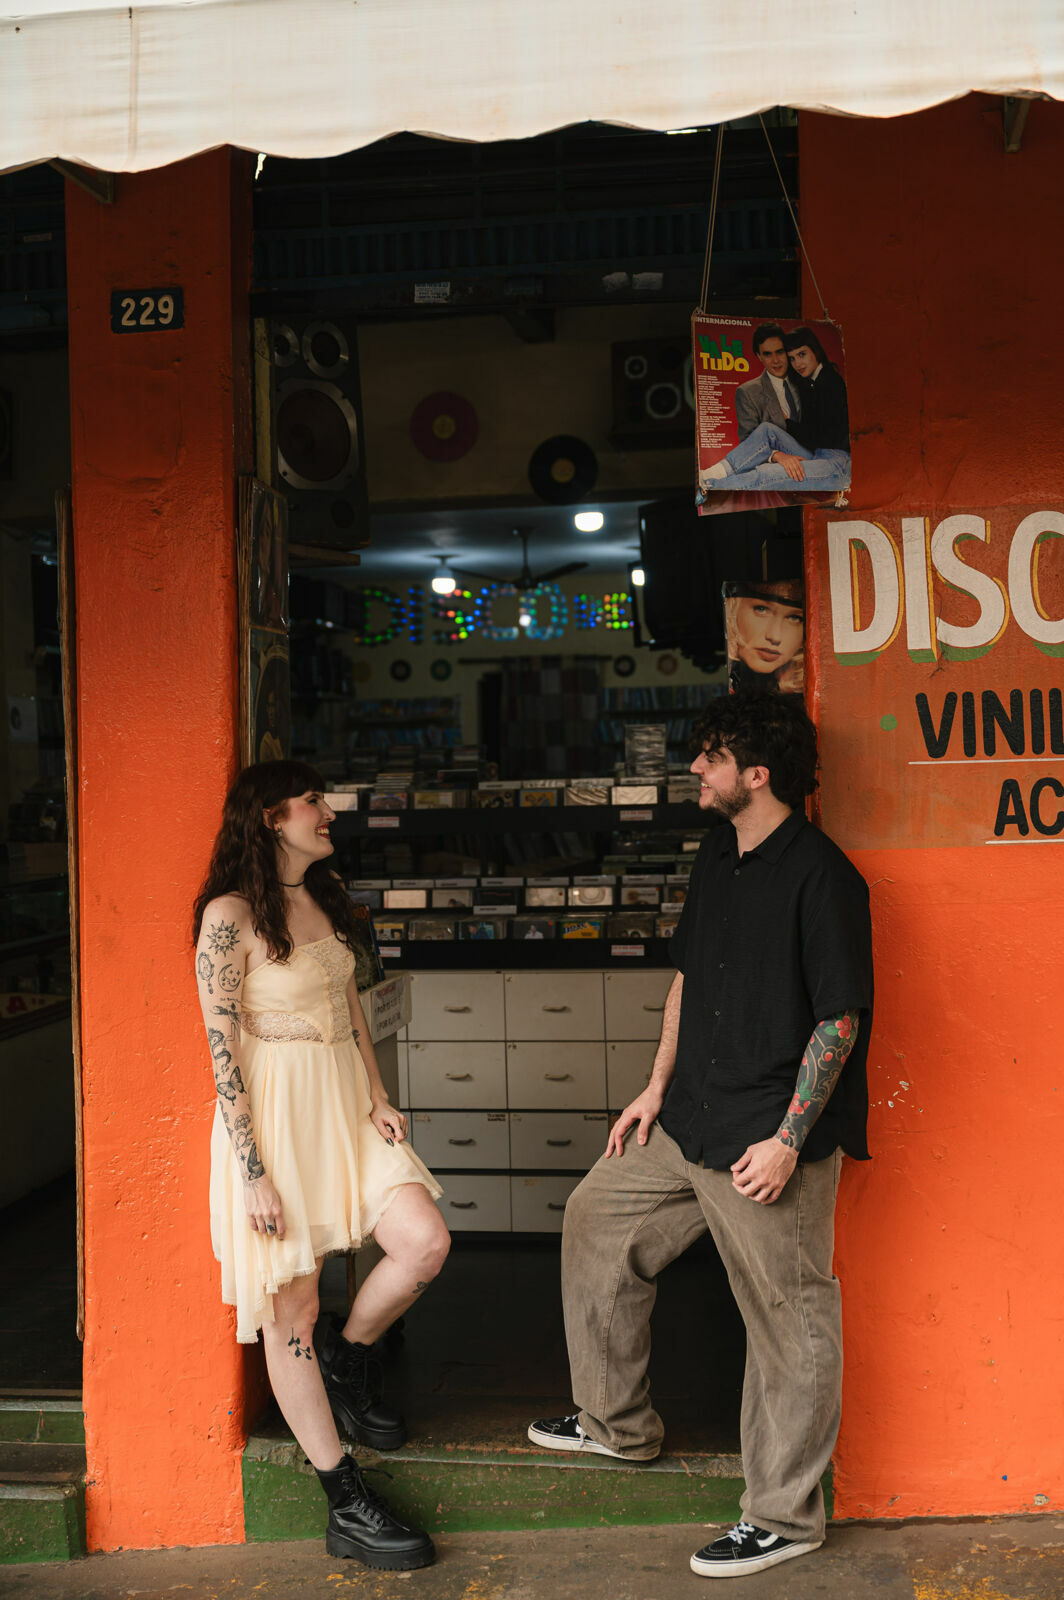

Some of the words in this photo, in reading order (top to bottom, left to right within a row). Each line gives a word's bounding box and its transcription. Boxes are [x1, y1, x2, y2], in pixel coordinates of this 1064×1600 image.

[120, 294, 174, 326] 229
[695, 316, 752, 327] INTERNACIONAL
[699, 351, 750, 373] TUDO
